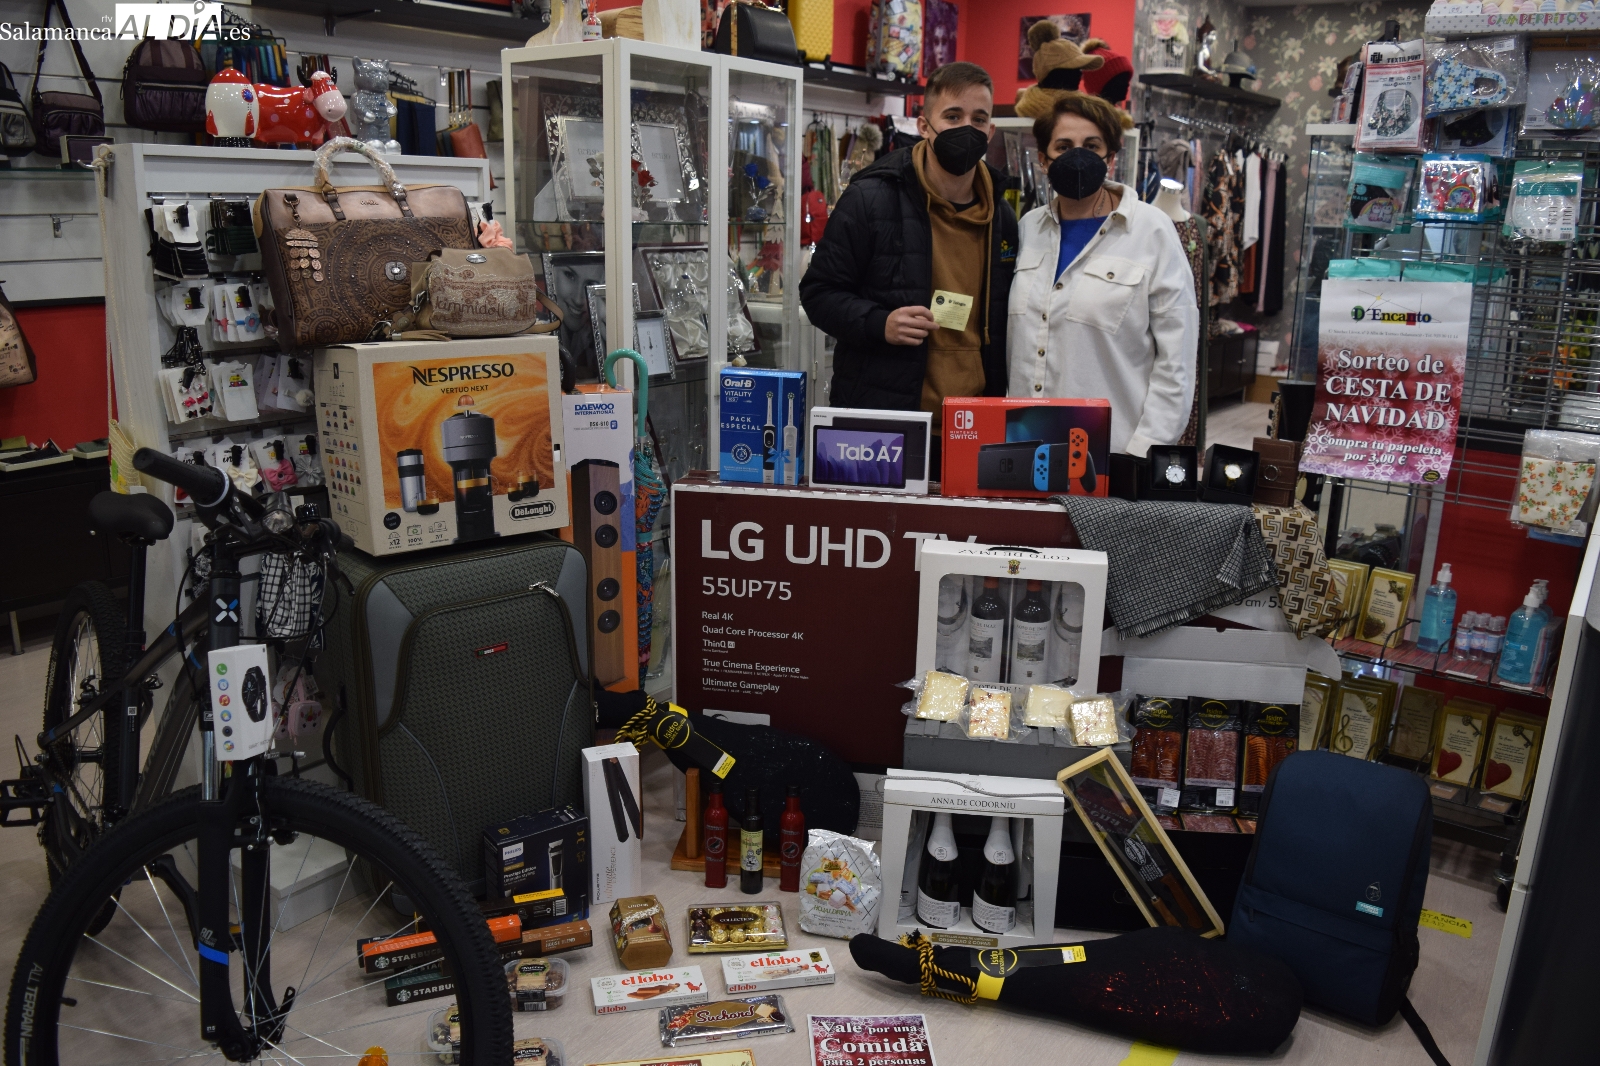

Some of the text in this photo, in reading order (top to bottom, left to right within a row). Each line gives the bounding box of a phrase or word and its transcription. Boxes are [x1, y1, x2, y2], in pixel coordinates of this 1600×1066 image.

[1338, 350, 1444, 374] Sorteo de
[408, 362, 515, 386] NESPRESSO
[724, 378, 752, 388] Oral-B
[1326, 376, 1452, 403] CESTA DE
[440, 386, 469, 395] VERTUO
[574, 403, 615, 411] DAEWOO
[730, 415, 752, 423] PACK
[1324, 403, 1446, 430] NAVIDAD
[720, 422, 761, 431] ESPECIAL
[1318, 434, 1443, 456] Compra tu papeleta
[836, 442, 903, 463] Tab A7
[1343, 452, 1408, 465] por 3,00 €
[701, 519, 765, 562] LG
[785, 524, 892, 569] UHD
[701, 576, 792, 601] 55UP75
[1245, 599, 1260, 608] cm
[1268, 596, 1282, 609] 5
[702, 611, 734, 621] Real 4K
[702, 625, 804, 640] Quad Core Processor 4K
[702, 639, 727, 649] ThinQ
[702, 659, 801, 674] True Cinema Experience
[702, 678, 780, 694] Ultimate Gameplay
[663, 721, 679, 739] Isidro
[930, 796, 955, 806] ANNA
[956, 799, 968, 807] DE
[750, 955, 801, 967] el lobo
[621, 973, 674, 986] el lobo
[729, 983, 757, 992] el lobo
[20, 962, 44, 1038] ALL TERRAIN
[597, 1005, 627, 1014] el lobo
[696, 1005, 755, 1023] Suchard
[820, 1022, 917, 1035] Vale por una
[820, 1037, 925, 1053] Comida
[822, 1057, 927, 1066] para 2 personas
